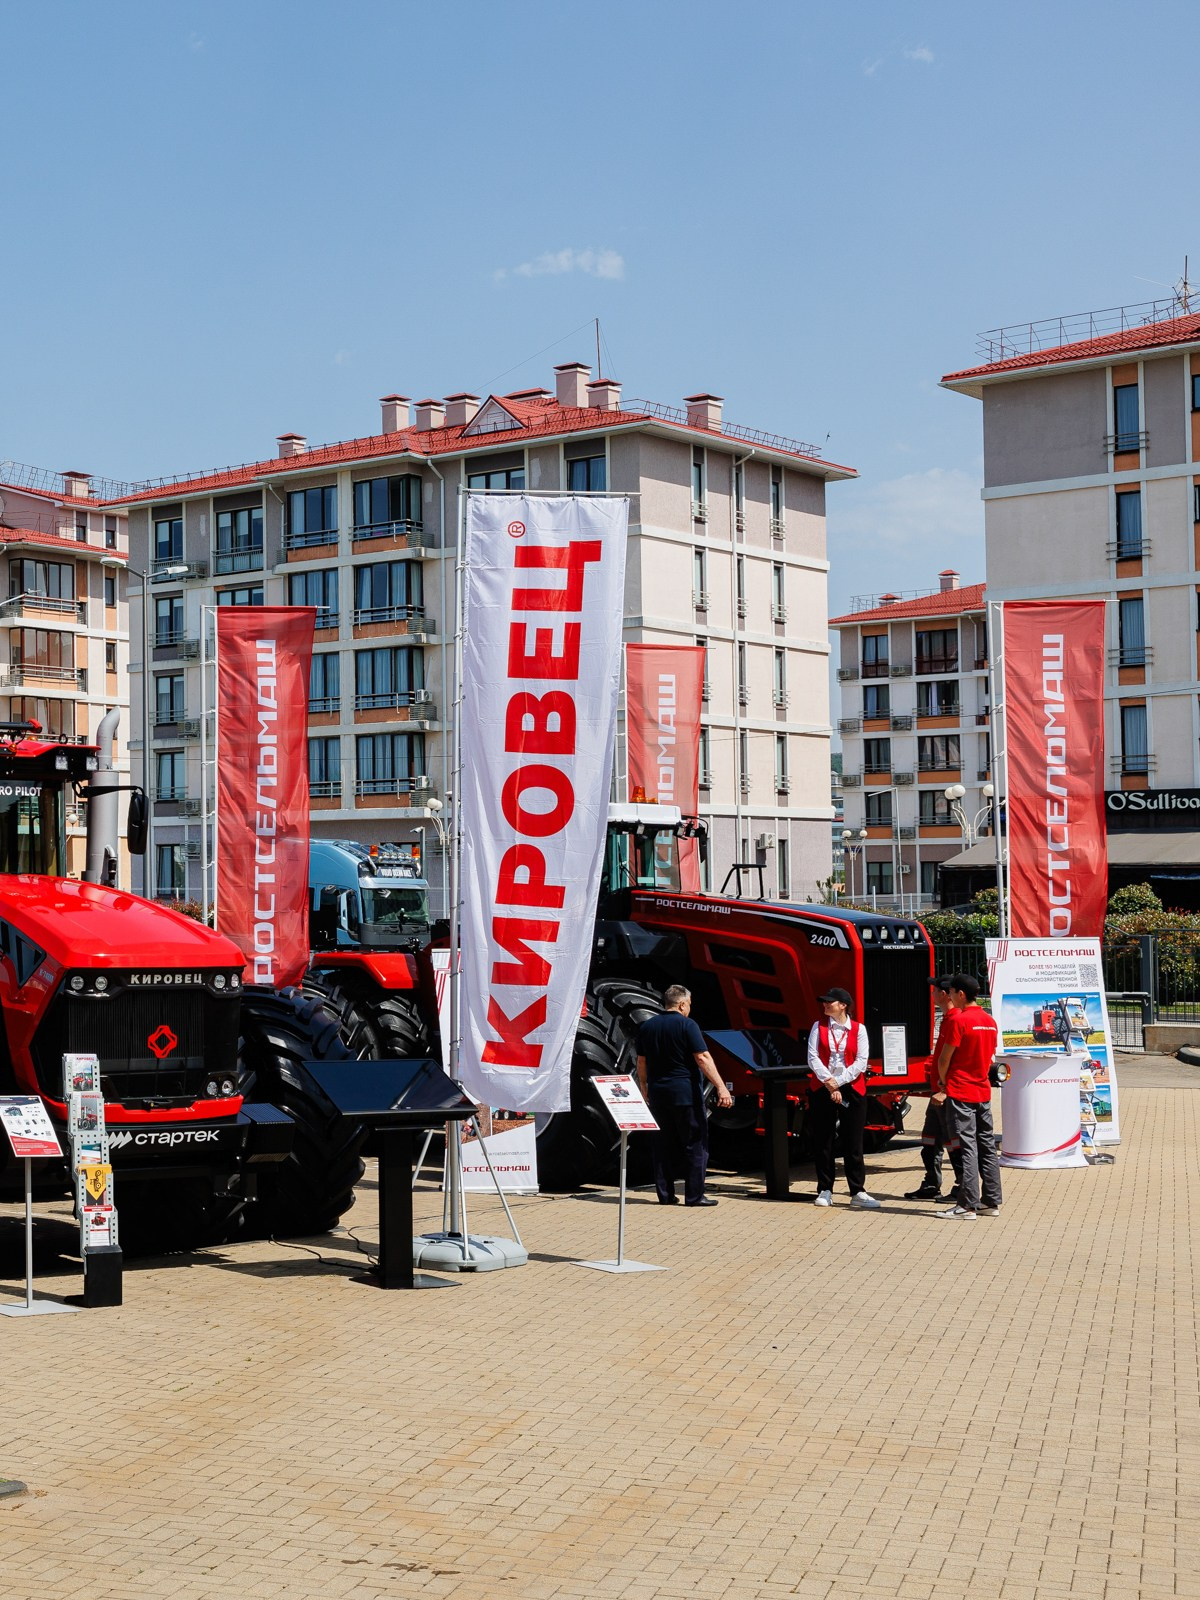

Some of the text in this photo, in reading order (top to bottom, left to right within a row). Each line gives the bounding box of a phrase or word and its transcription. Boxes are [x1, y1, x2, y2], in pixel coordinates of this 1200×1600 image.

[15, 786, 42, 797] PILOT
[1043, 634, 1072, 937] ОСТСЕЛЬМАШ
[481, 540, 602, 1068] КИРОВЕЦ
[254, 640, 277, 983] РОСТСЕЛЬМАШ
[656, 898, 731, 914] РОСТСЕЛЬМАШ
[810, 934, 837, 947] 2400
[1014, 949, 1096, 957] РОСТСЕЛЬМАШ
[130, 973, 202, 984] КИРОВЕЦ
[134, 1130, 220, 1147] стартек
[462, 1165, 530, 1173] ОСТСЕЛЬМАШ
